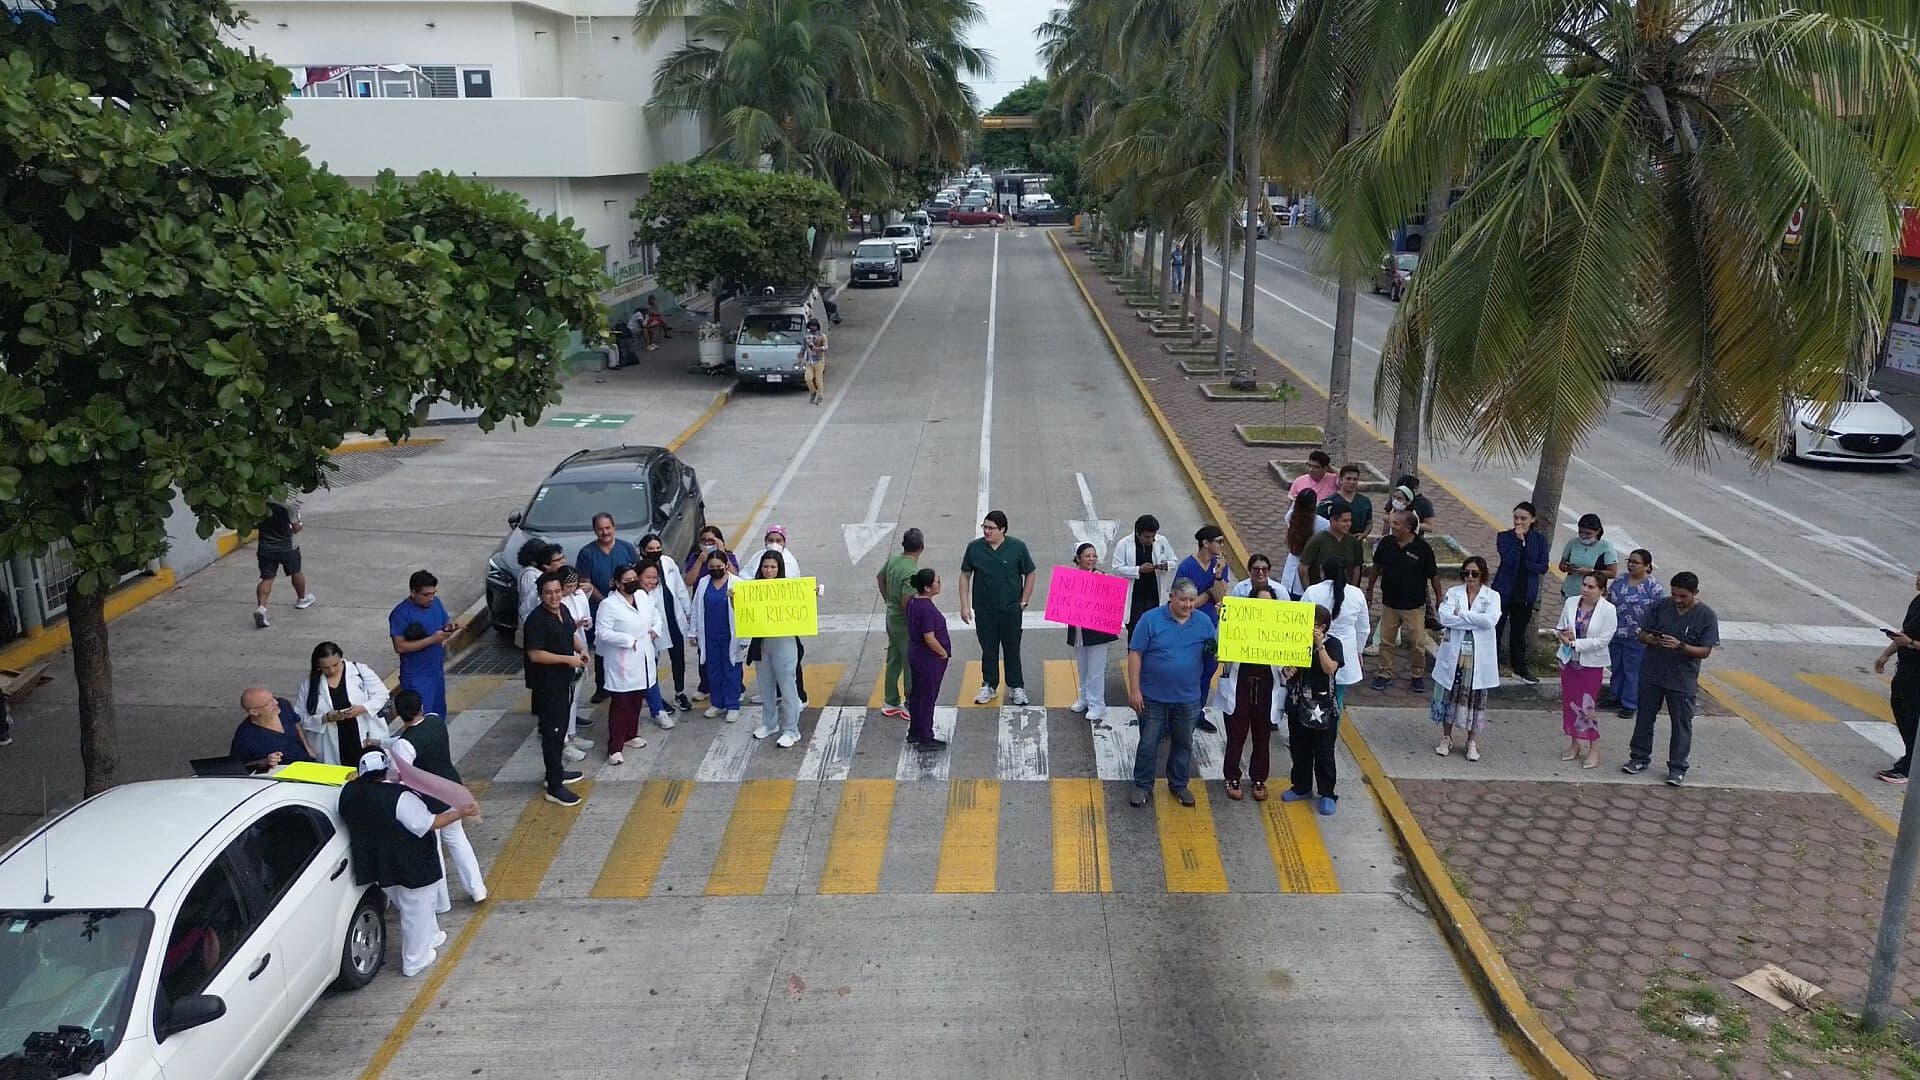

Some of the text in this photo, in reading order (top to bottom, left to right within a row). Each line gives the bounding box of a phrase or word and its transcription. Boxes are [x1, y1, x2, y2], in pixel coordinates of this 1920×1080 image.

[742, 581, 807, 602] TRABAJAMOS
[1059, 576, 1121, 600] NO TENEMOS
[1051, 594, 1071, 608] CON
[740, 605, 808, 623] EN RIESGO
[1051, 608, 1060, 617] A
[1276, 610, 1309, 627] ESTAN
[1225, 624, 1310, 643] LOS INSUMOS
